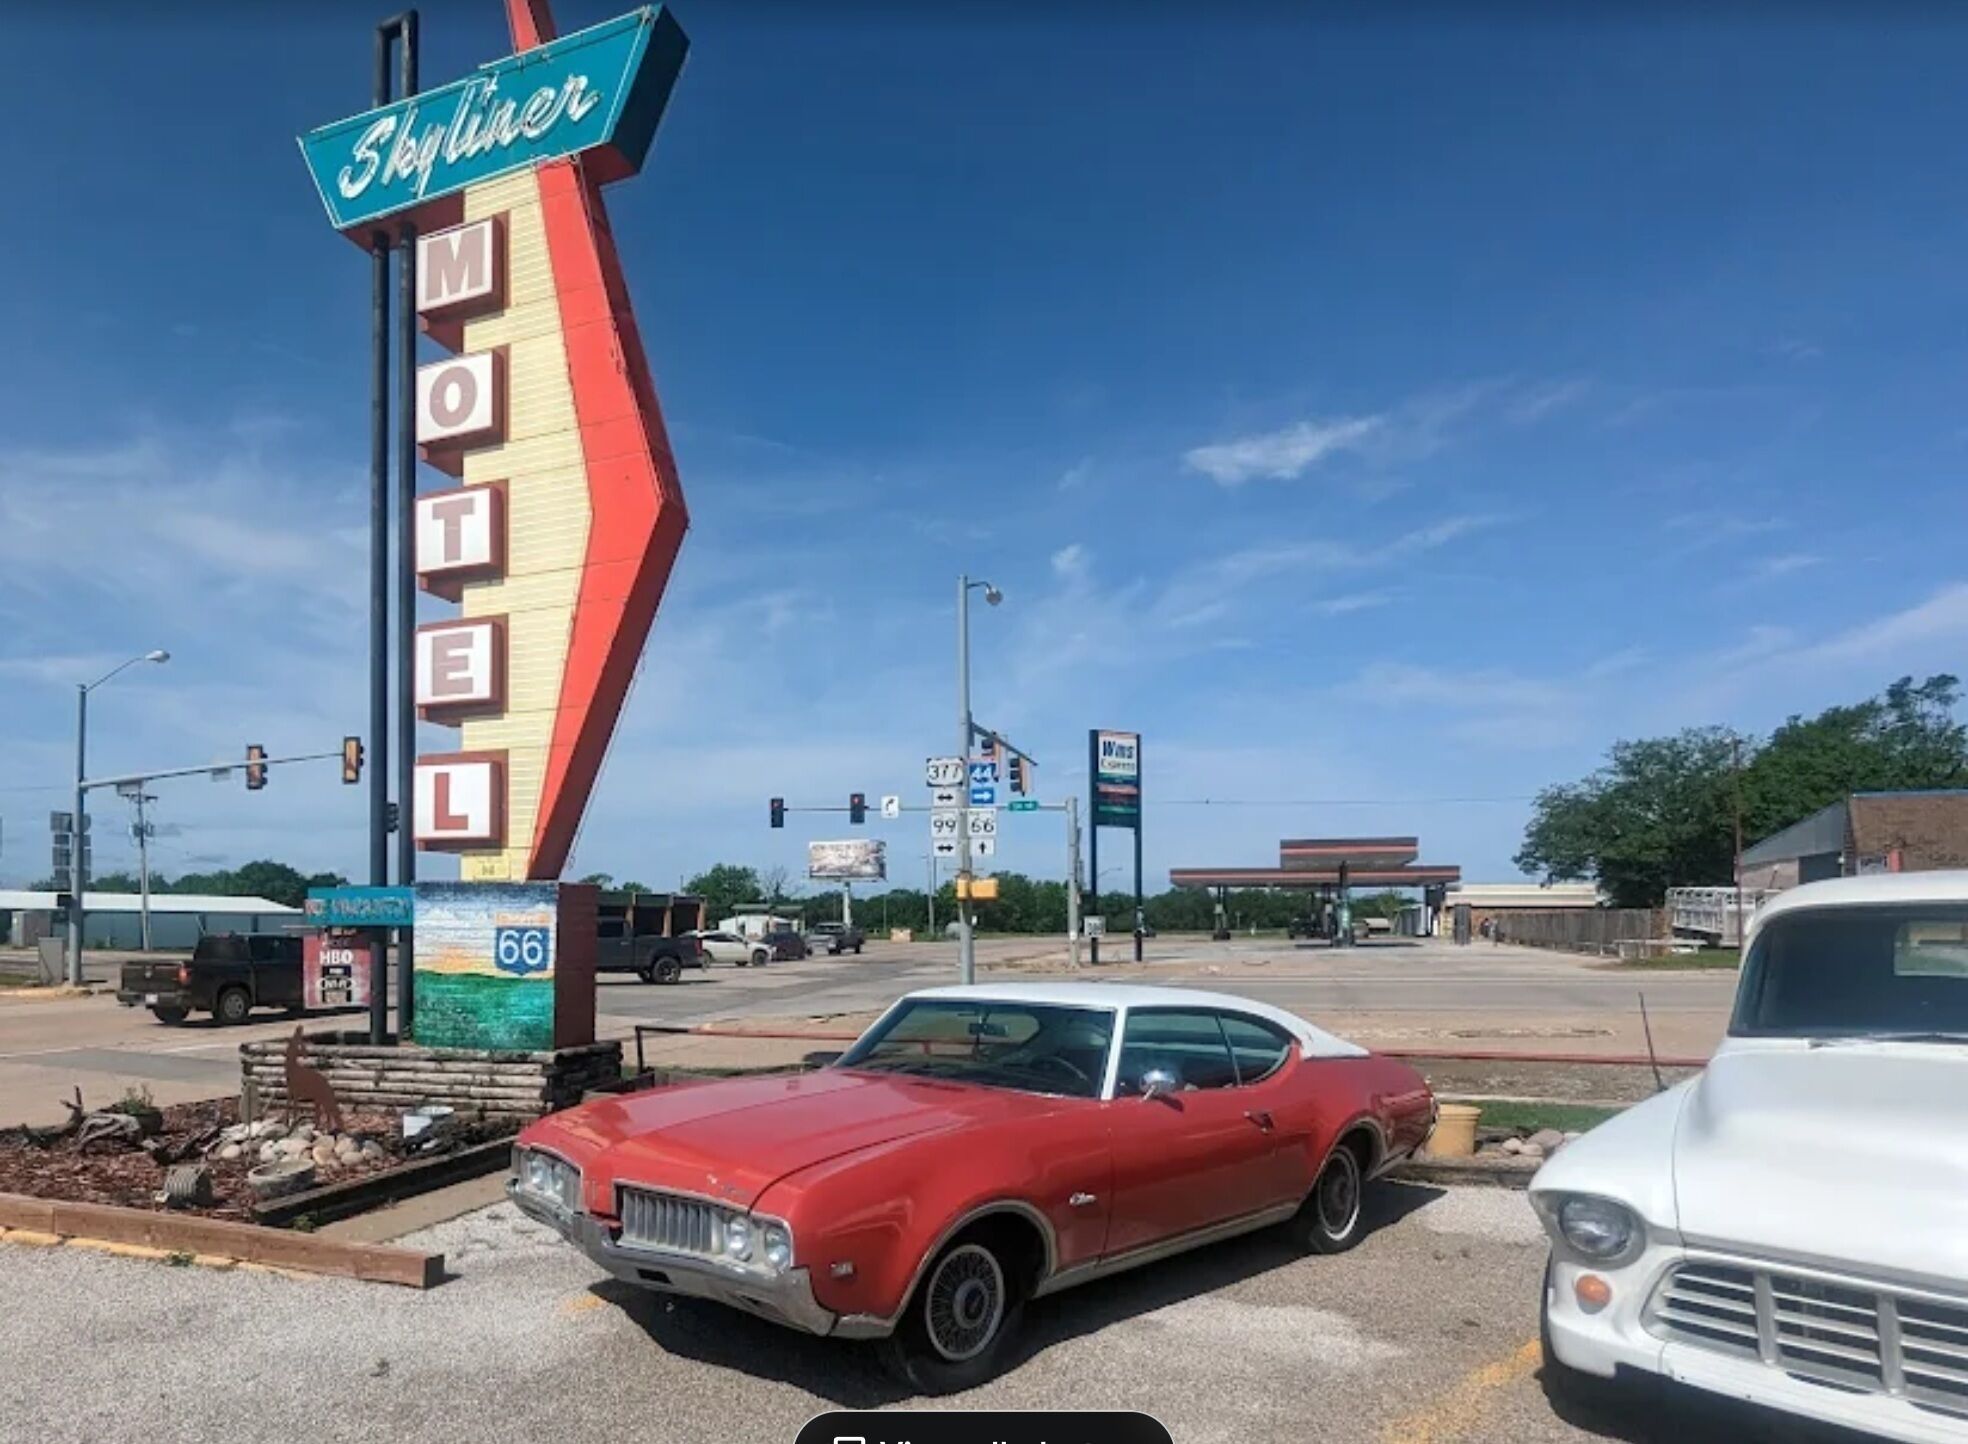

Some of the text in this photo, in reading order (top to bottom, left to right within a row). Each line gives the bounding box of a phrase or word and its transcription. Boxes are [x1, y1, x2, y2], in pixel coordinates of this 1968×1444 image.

[337, 71, 600, 199] Skyliner
[425, 226, 485, 831] MOTEL
[929, 764, 960, 780] 377
[971, 765, 992, 780] 44
[933, 818, 956, 833] 99
[971, 818, 994, 833] 66
[499, 930, 543, 966] 66
[319, 949, 354, 966] HBO
